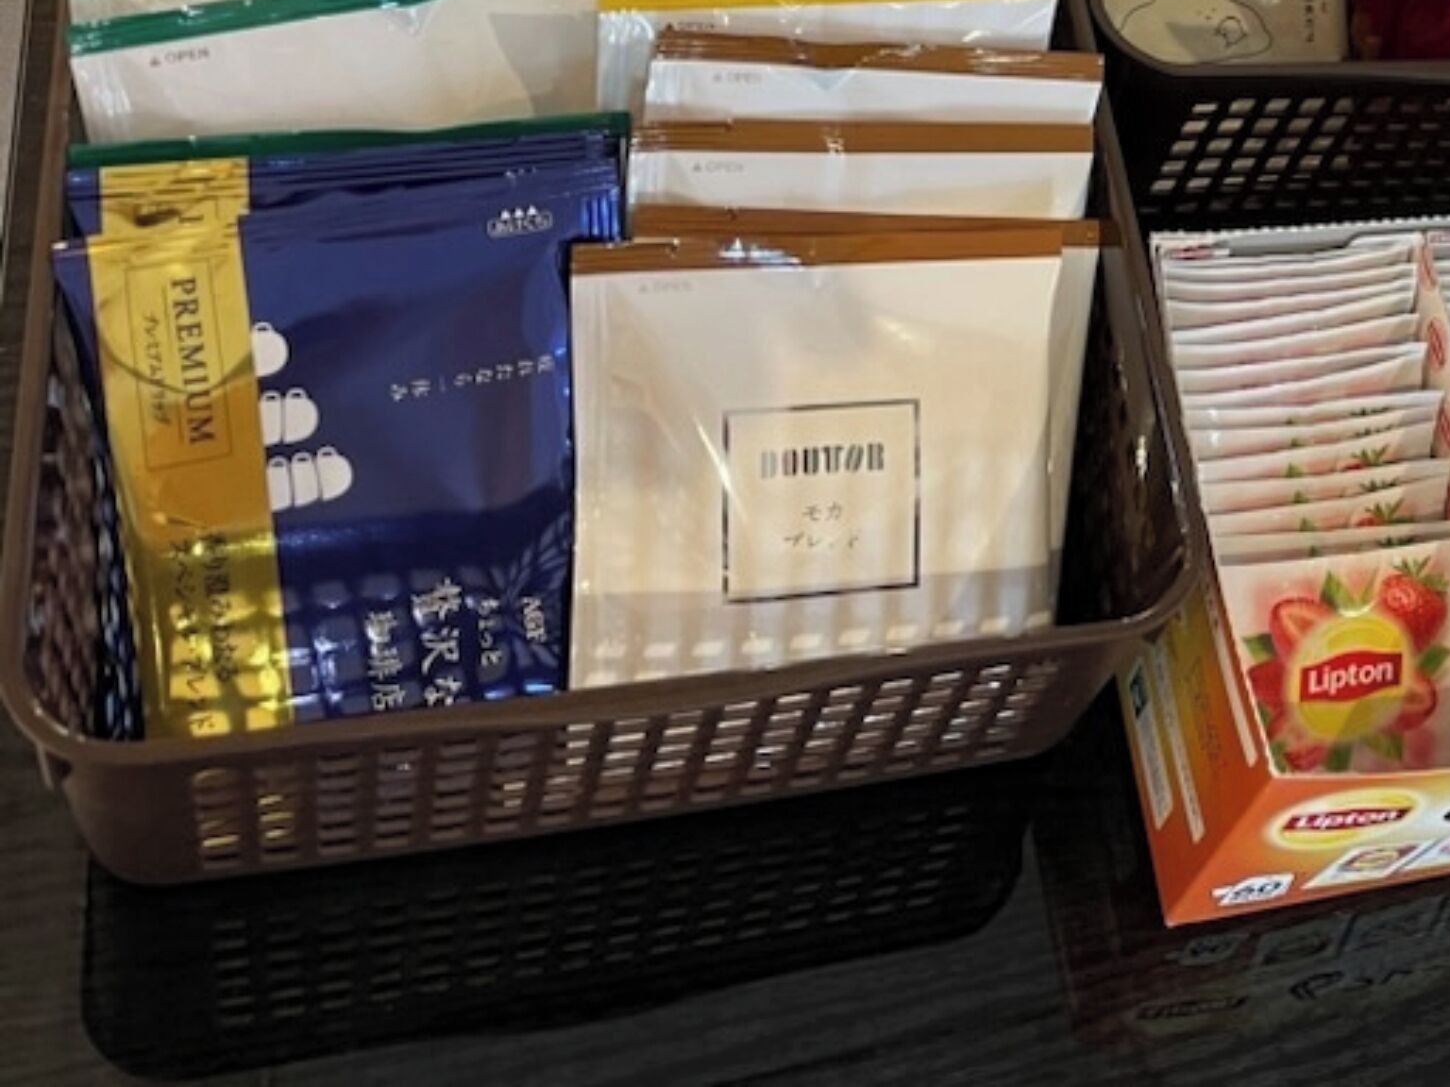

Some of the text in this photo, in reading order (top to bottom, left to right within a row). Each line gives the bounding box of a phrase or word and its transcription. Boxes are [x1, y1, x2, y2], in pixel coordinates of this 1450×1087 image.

[171, 276, 216, 445] PREMIUM
[761, 442, 885, 481] DOUTOR
[802, 502, 843, 521] モカ
[1307, 662, 1394, 695] Lipton
[1295, 811, 1400, 829] Lipton
